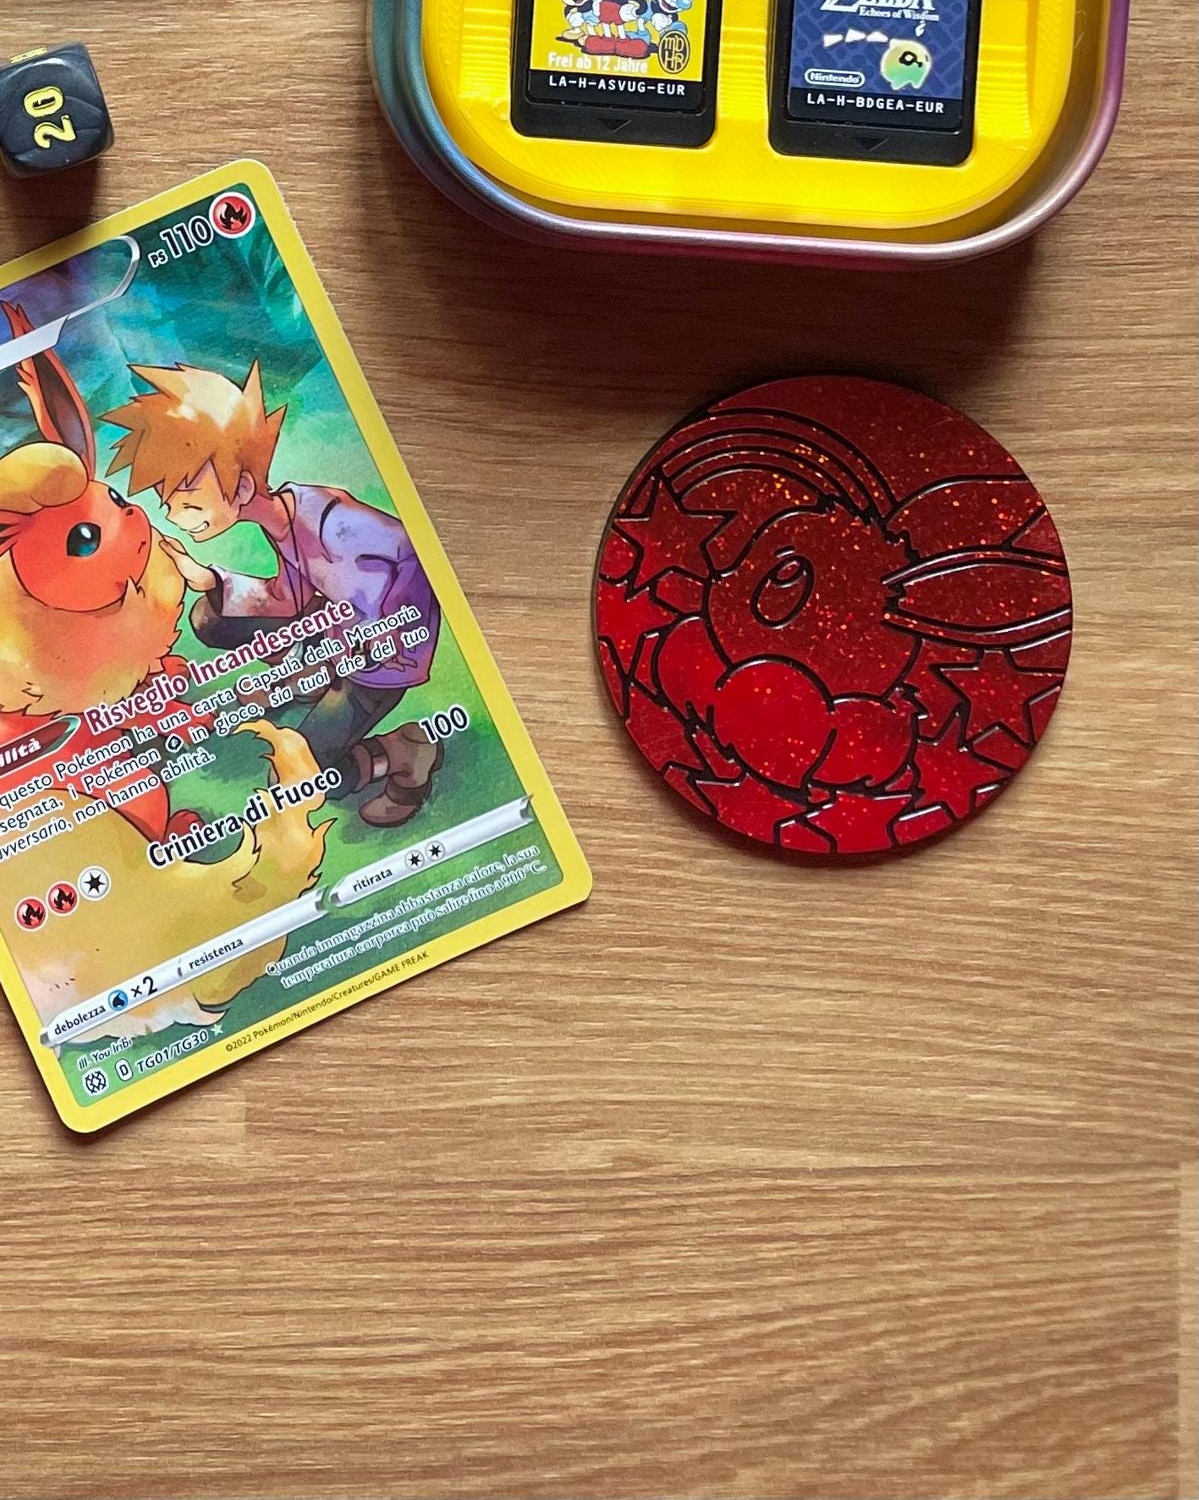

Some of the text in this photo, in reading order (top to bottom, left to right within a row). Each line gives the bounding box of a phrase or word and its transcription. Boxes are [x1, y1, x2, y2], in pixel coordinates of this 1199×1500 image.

[860, 6, 939, 21] Echoes Wisdom
[548, 52, 648, 73] Frei ab 12 Jahre
[549, 75, 685, 95] LA-H-ASVUG-EUR
[807, 93, 944, 113] LA-H-BDGEA-EUR
[24, 86, 76, 149] 20
[148, 216, 213, 268] PS 110
[86, 675, 187, 734] Risveglio
[190, 600, 353, 685] Incandescente
[0, 774, 52, 809] questo
[56, 735, 133, 778] Pokémon
[134, 726, 154, 743] ha
[160, 710, 189, 731] una
[193, 686, 233, 716] carta
[238, 657, 301, 693] Capsula
[305, 638, 343, 665] della
[346, 605, 420, 645] Memoria
[83, 749, 161, 792] Pokémon
[192, 726, 207, 741] in
[216, 704, 264, 734] gioco,
[271, 687, 291, 706] sia
[301, 668, 328, 692] tuoi
[337, 657, 364, 676] che
[372, 638, 395, 661] del
[403, 628, 429, 648] tuo
[76, 801, 107, 822] non
[108, 776, 159, 808] hanno
[163, 746, 215, 781] abilità.
[148, 705, 469, 867] Criniera di Fuoco 100
[353, 868, 393, 893] ritirata
[266, 879, 464, 976] Quando abbastanza
[281, 895, 469, 988] temperatura corporea salire
[189, 938, 244, 969] resistenza
[401, 951, 429, 968] FREAK
[54, 1005, 106, 1035] debolezza
[92, 1050, 110, 1062] You
[137, 1030, 209, 1073] TG01/TG30
